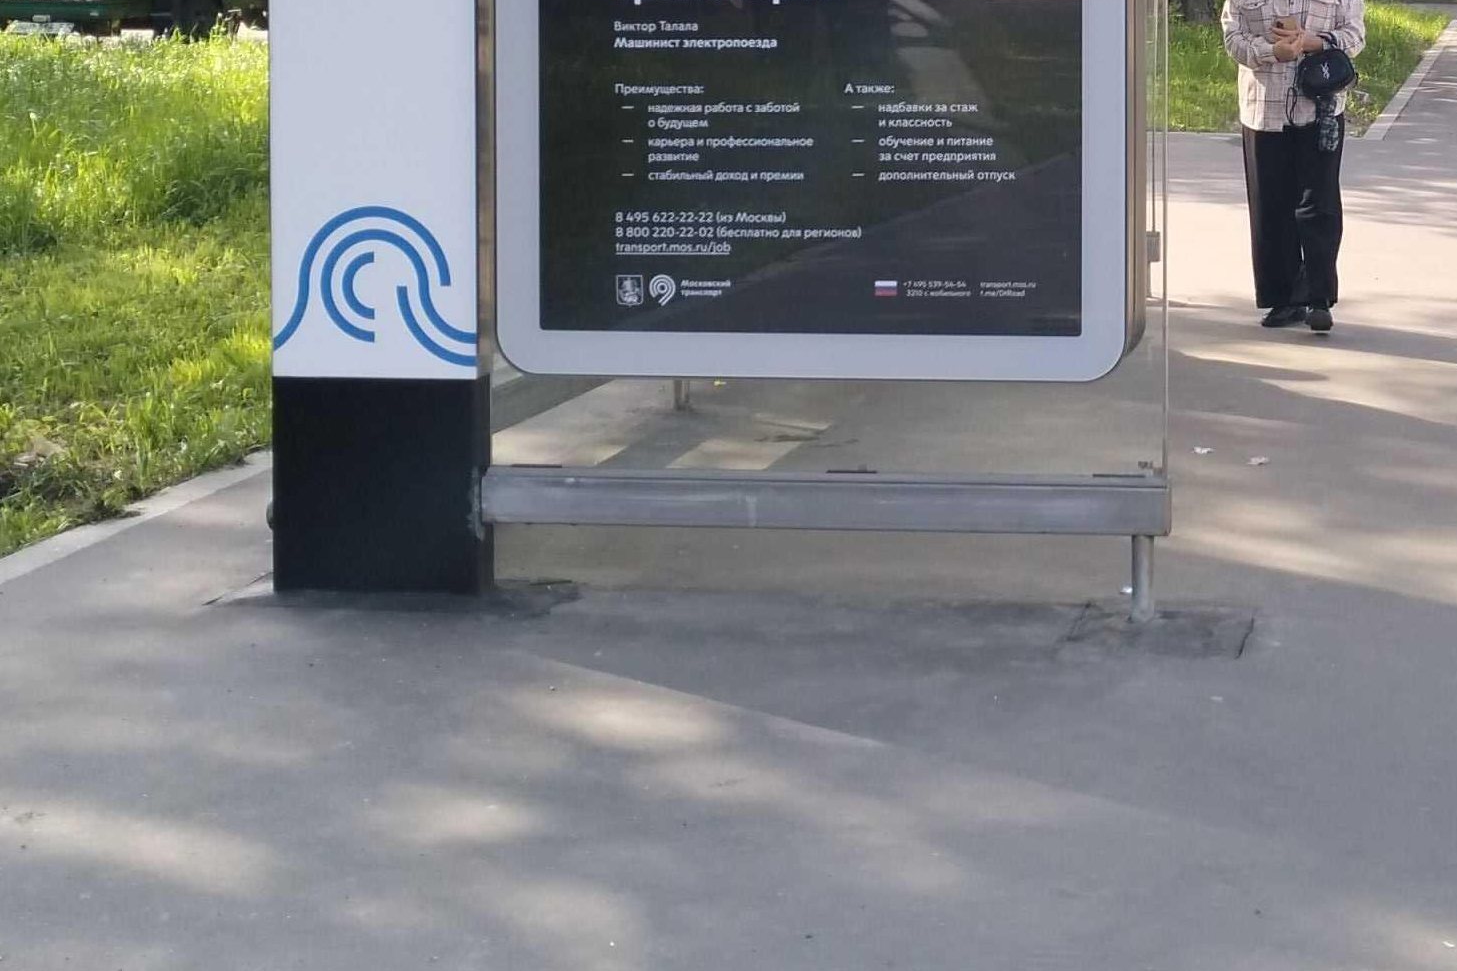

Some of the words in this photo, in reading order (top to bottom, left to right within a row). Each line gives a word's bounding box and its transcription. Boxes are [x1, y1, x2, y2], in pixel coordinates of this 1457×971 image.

[614, 21, 656, 32] Виктор
[659, 21, 698, 31] Талала
[614, 37, 680, 48] Машинист
[683, 38, 777, 49] электропоезда
[615, 84, 704, 95] Преимущества:
[844, 84, 853, 93] А
[857, 85, 895, 94] также:
[648, 104, 702, 113] надежная
[704, 102, 743, 114] работа
[755, 102, 799, 112] заботой
[878, 102, 932, 113] надбавки
[934, 104, 947, 112] за
[950, 104, 978, 112] стаж
[657, 117, 708, 129] будущем
[879, 119, 886, 127] и
[888, 119, 952, 127] классность
[648, 138, 694, 147] карьера
[706, 136, 813, 147] профессиональное
[879, 135, 934, 148] обучение
[937, 137, 944, 145] и
[947, 137, 993, 146] питание
[648, 153, 699, 162] развитие
[879, 153, 891, 161] за
[894, 153, 919, 161] счет
[921, 153, 996, 162] предприятия
[648, 170, 713, 179] стабильный
[715, 172, 748, 181] доход
[760, 172, 804, 181] премии
[878, 170, 974, 181] дополнительный
[977, 172, 1016, 182] отпуск
[615, 213, 623, 222] 8
[626, 212, 649, 222] 495
[652, 213, 713, 222] 622-22-22
[716, 212, 733, 224] (из
[736, 212, 786, 224] Москвы)
[616, 228, 623, 237] 8
[626, 228, 649, 237] 800
[652, 228, 713, 237] 220-22-02
[716, 227, 779, 238] (бесплатно
[781, 229, 801, 239] для
[803, 228, 862, 239] регионов)
[615, 242, 731, 254] transport.mos.ru/job
[681, 279, 731, 288] Московский
